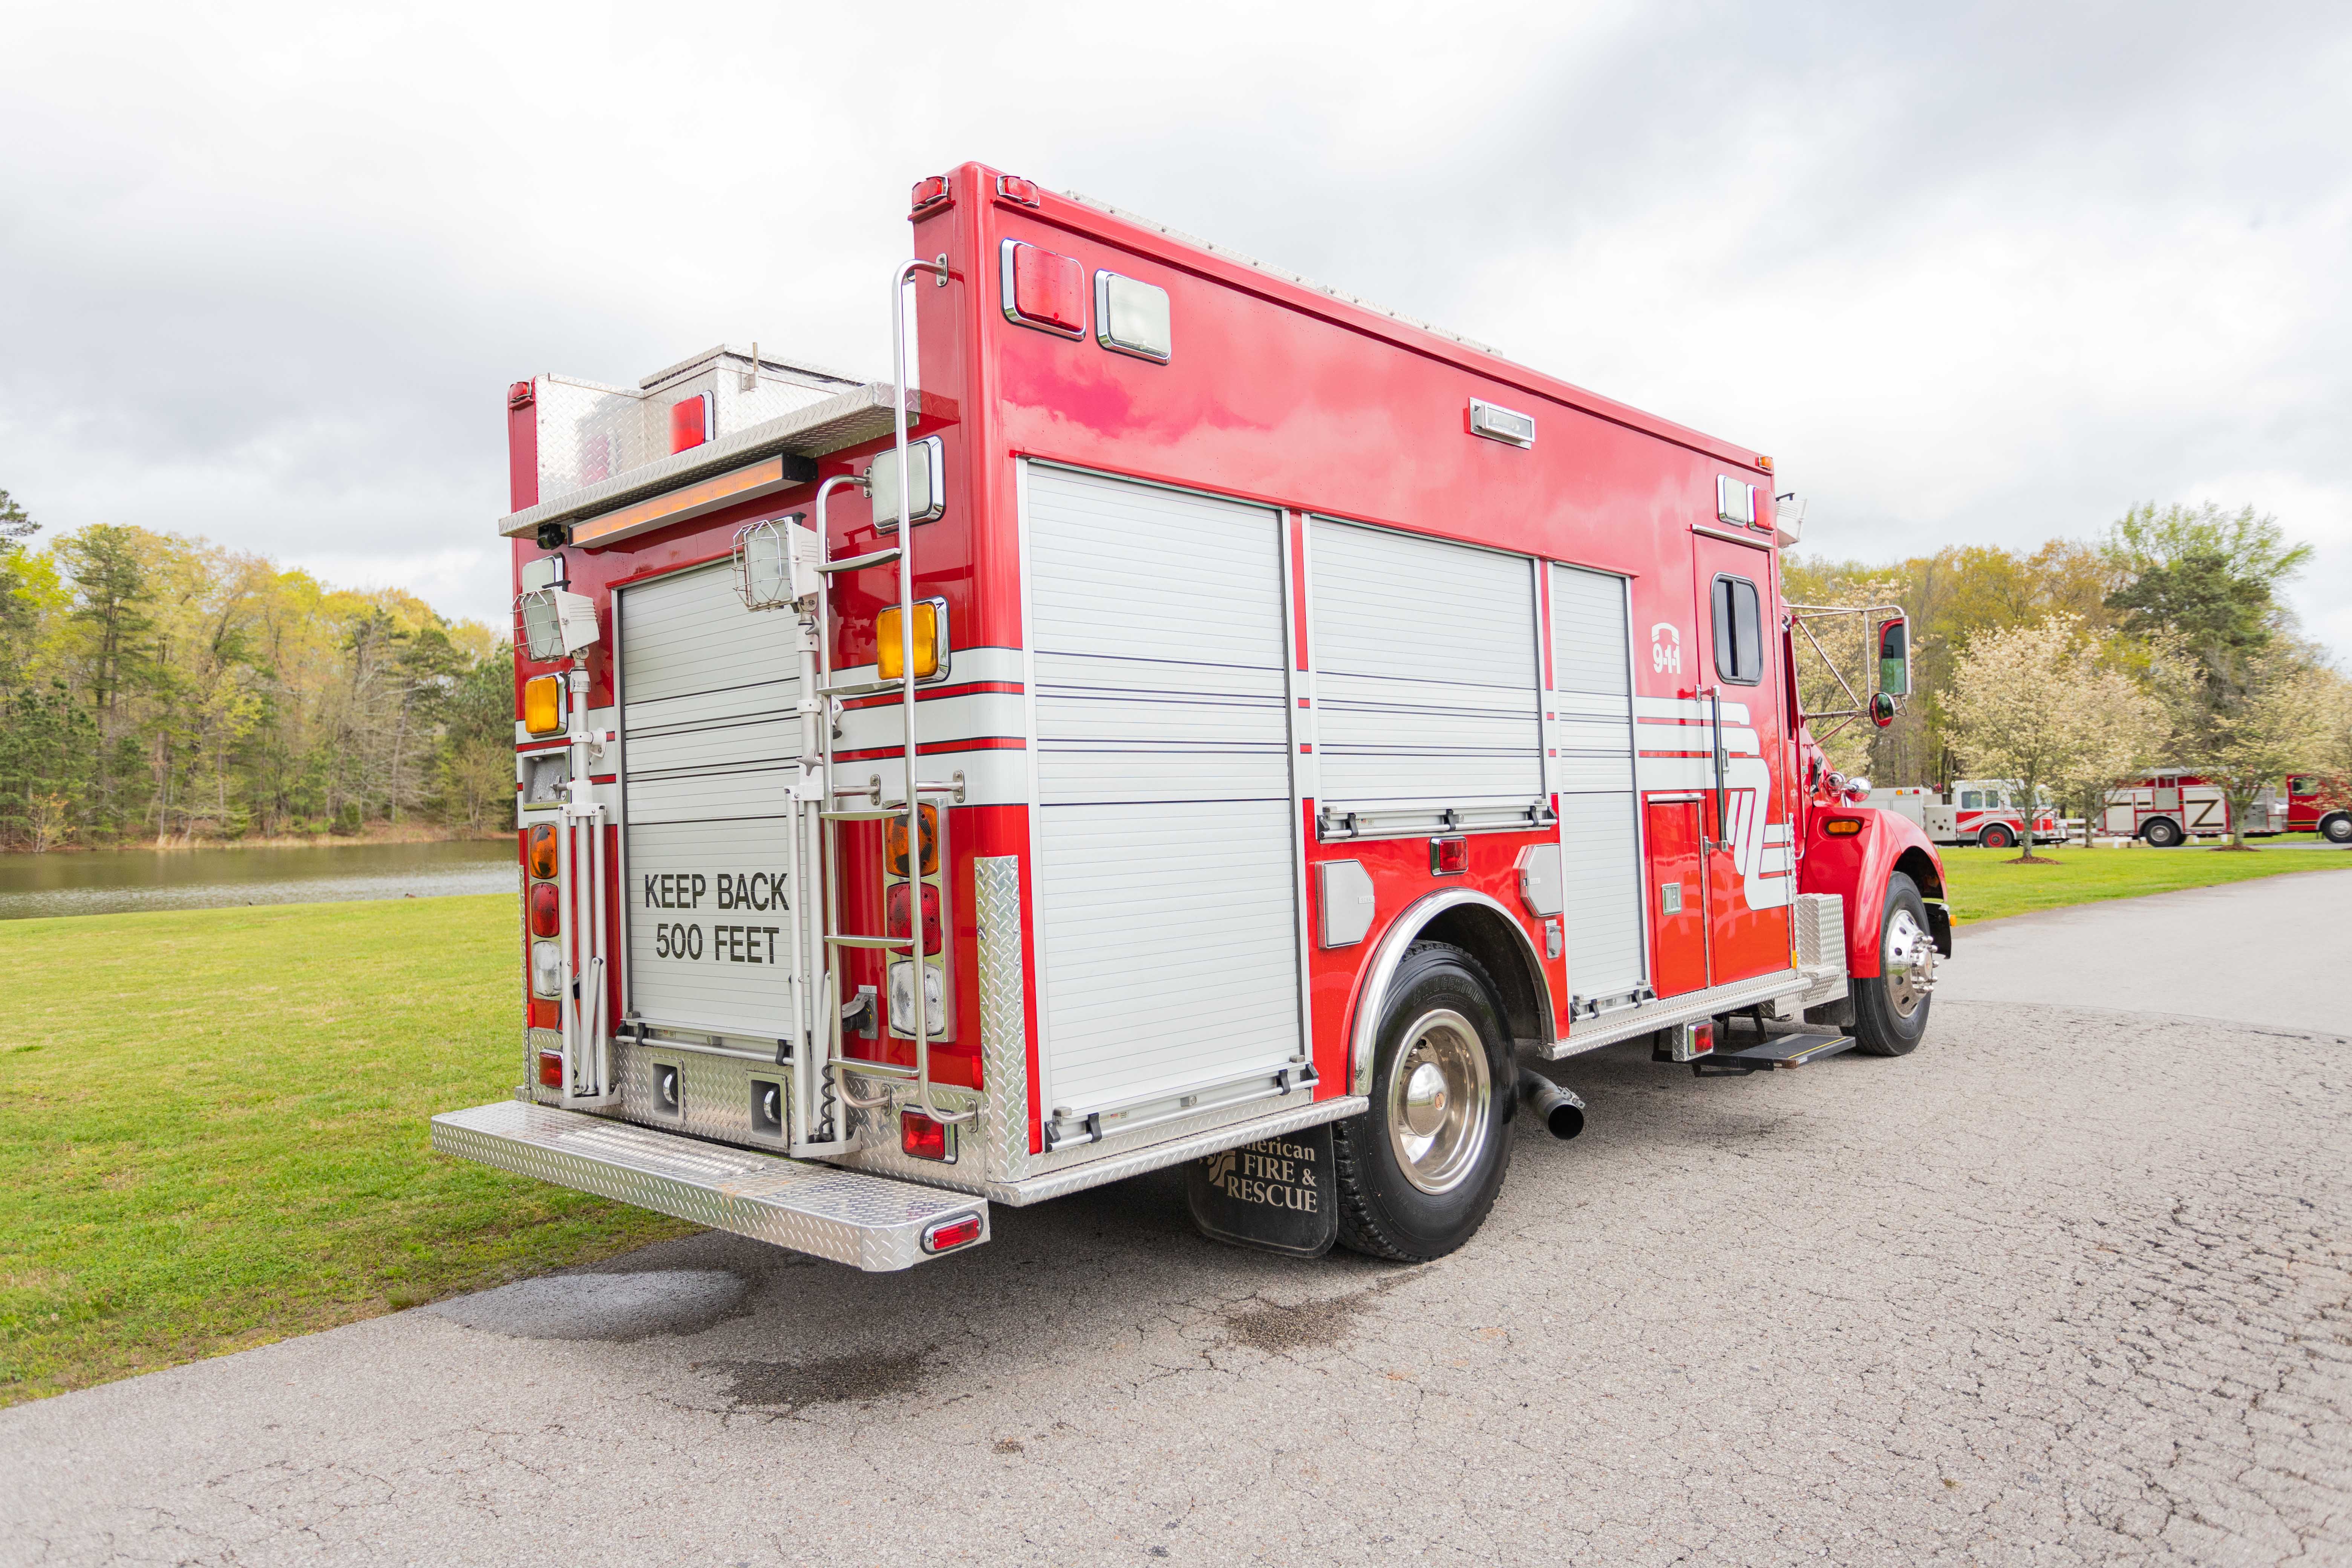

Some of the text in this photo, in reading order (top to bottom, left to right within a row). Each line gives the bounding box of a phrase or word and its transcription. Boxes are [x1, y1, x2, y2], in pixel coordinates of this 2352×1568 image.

[645, 872, 790, 911] KEEP BACK
[656, 923, 779, 964] 500 FEET
[1242, 1136, 1315, 1161] erican
[1243, 1153, 1317, 1187] FIRE &
[1227, 1174, 1318, 1213] RESCUE
